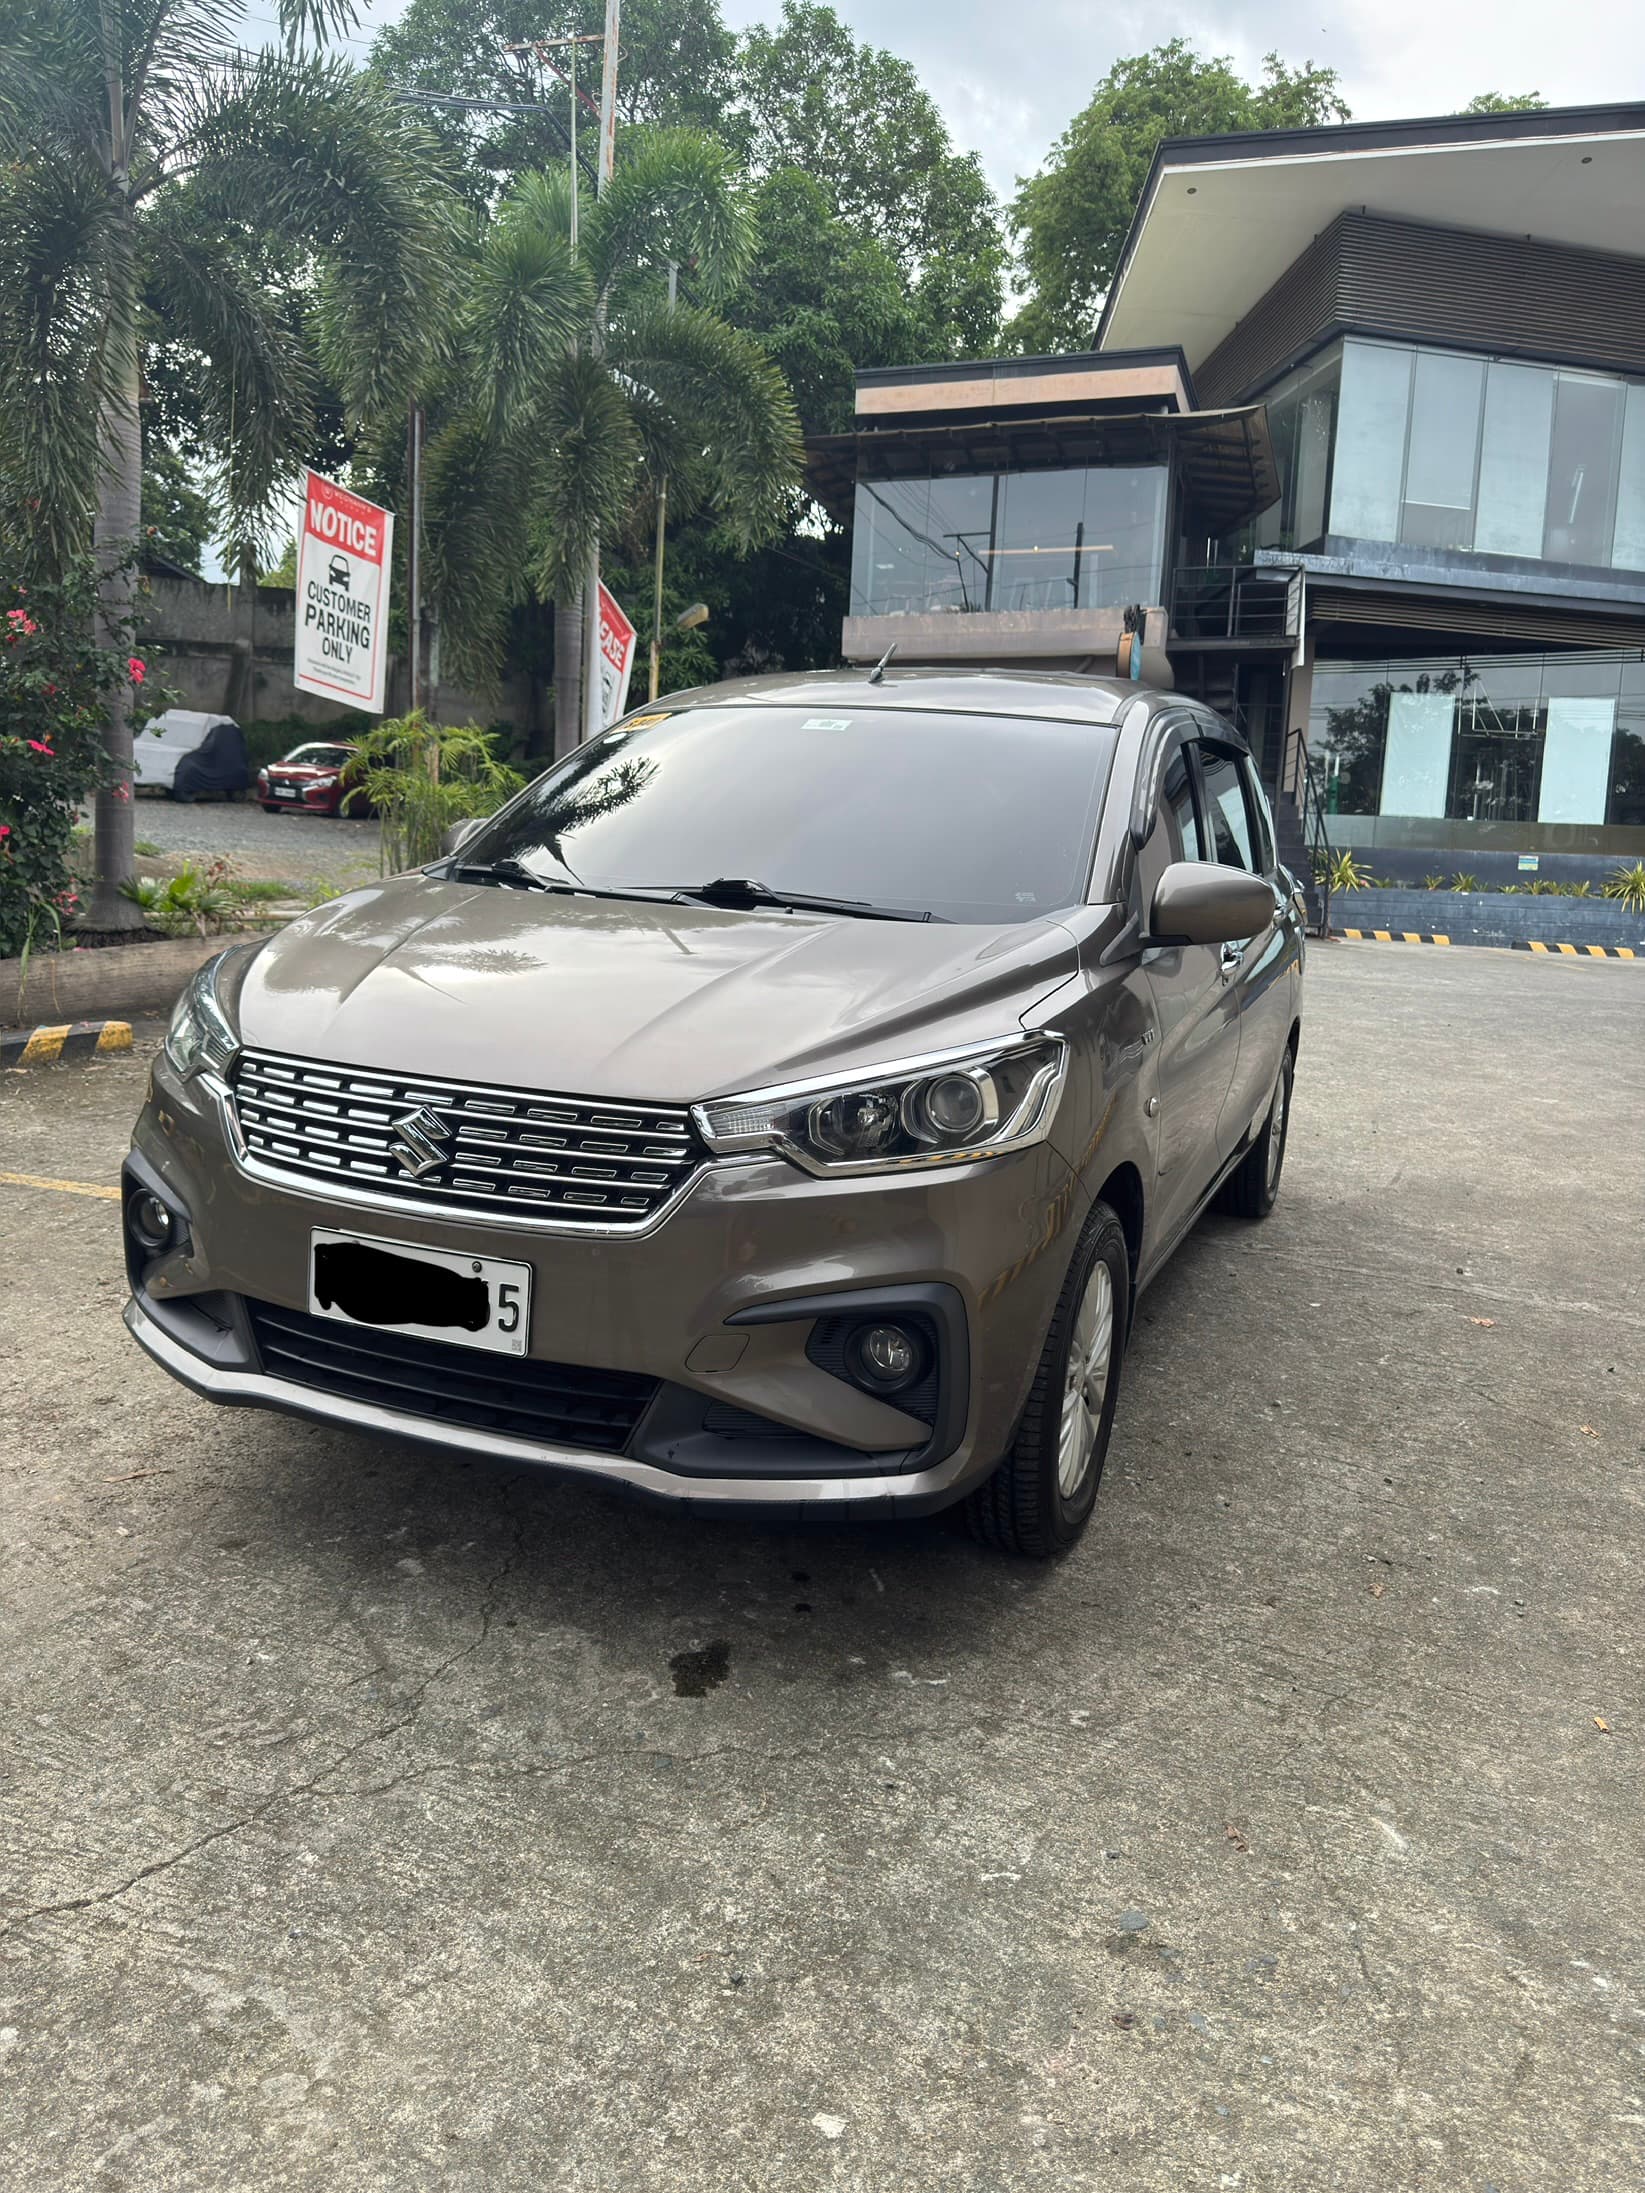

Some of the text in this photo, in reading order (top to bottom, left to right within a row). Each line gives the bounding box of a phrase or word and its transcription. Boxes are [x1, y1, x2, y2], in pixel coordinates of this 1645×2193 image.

[310, 499, 377, 557] NOTICE
[308, 580, 371, 623] CUSTOMER
[305, 603, 370, 650] PARKING
[600, 621, 625, 669] EASE
[322, 637, 353, 664] ONLY
